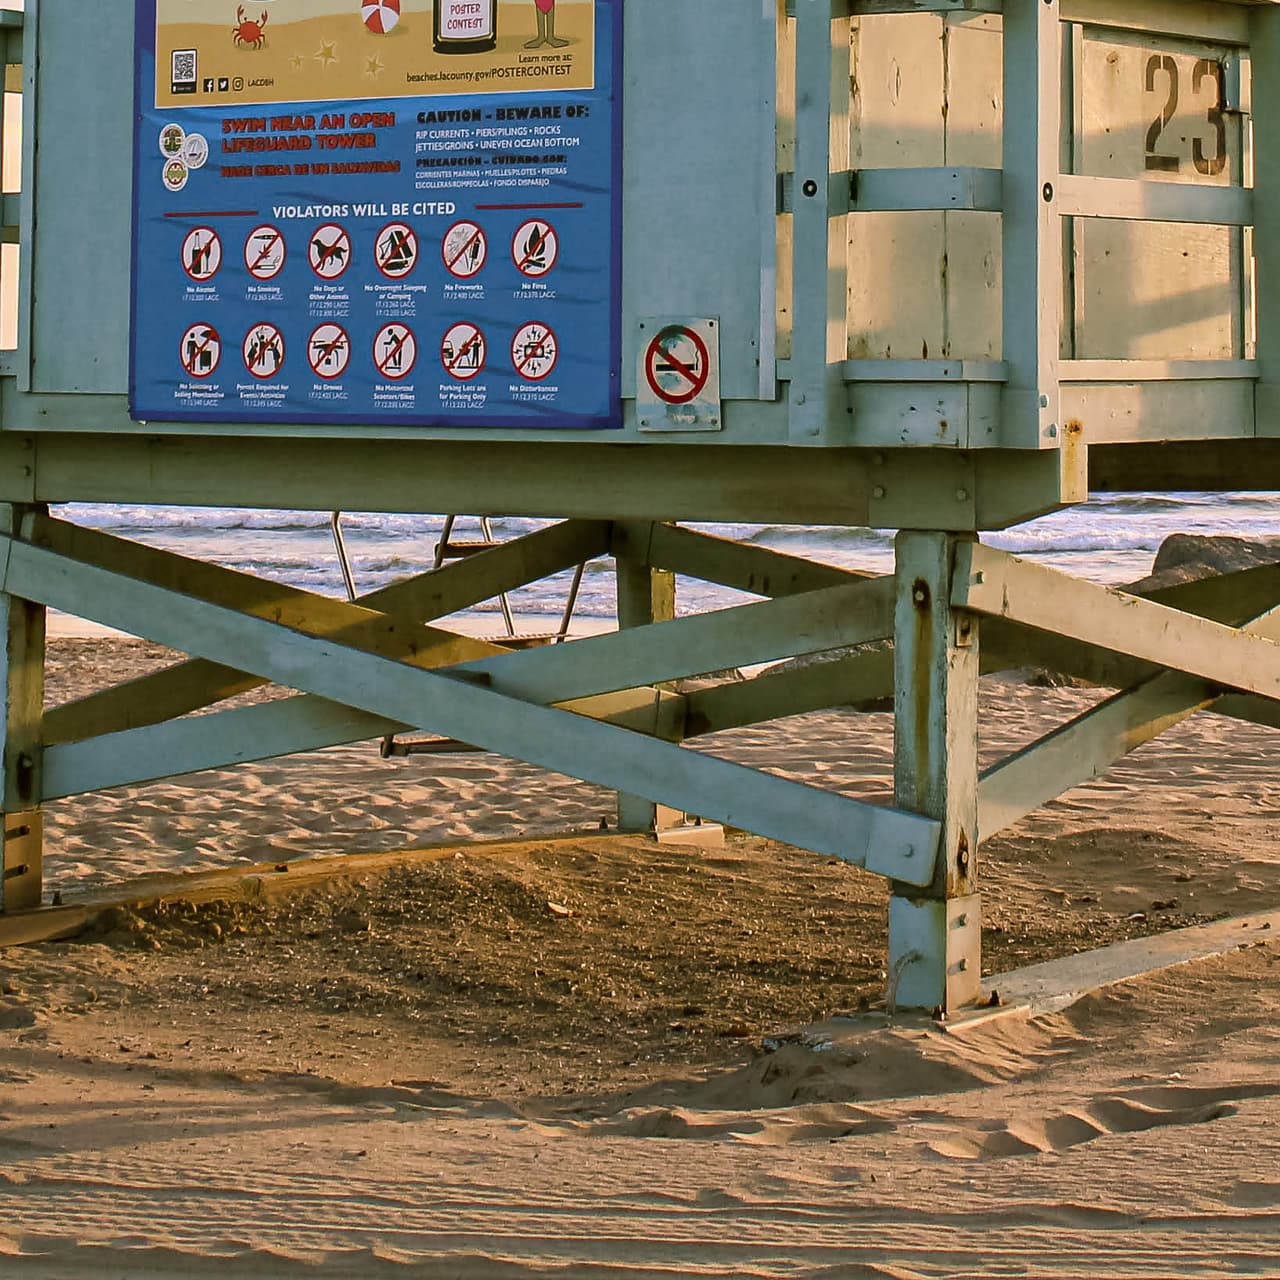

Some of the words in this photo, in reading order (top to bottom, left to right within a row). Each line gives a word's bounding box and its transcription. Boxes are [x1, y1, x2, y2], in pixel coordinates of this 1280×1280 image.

[450, 4, 481, 15] POSTER
[447, 18, 483, 30] CONTEST
[519, 54, 540, 63] Learn
[541, 55, 560, 63] more
[406, 64, 572, 82] beaches.lacounty.gov/POSTERCONTEST
[417, 109, 482, 124] CAUTION
[495, 106, 562, 121] BEWARE
[566, 105, 590, 118] OF:
[1145, 55, 1226, 176] 23
[222, 118, 266, 134] SWIM
[271, 116, 315, 132] NEAR
[320, 114, 345, 129] AN
[350, 112, 396, 128] OPEN
[415, 130, 428, 139] RIP
[429, 129, 470, 139] CURRENTS
[475, 127, 528, 137] PIERS/PILINGS
[534, 125, 561, 135] ROCKS
[222, 135, 312, 153] LIFEGUARD
[316, 133, 376, 150] TOWER
[415, 142, 474, 153] JETTIES/GROINS
[480, 139, 513, 149] UNEVEN
[514, 138, 543, 148] OCEAN
[544, 137, 580, 147] BOTTOM
[415, 171, 452, 179] CORRIENTES
[493, 178, 516, 187] FONDO
[273, 205, 349, 218] VIOLATORS
[352, 203, 388, 217] WILL
[391, 203, 409, 216] BE
[412, 202, 456, 216] CITED
[323, 285, 336, 294] Dogs
[454, 283, 484, 291] Fireworks
[439, 385, 462, 393] Parking
[449, 393, 471, 402] Parking
[472, 393, 487, 402] Only
